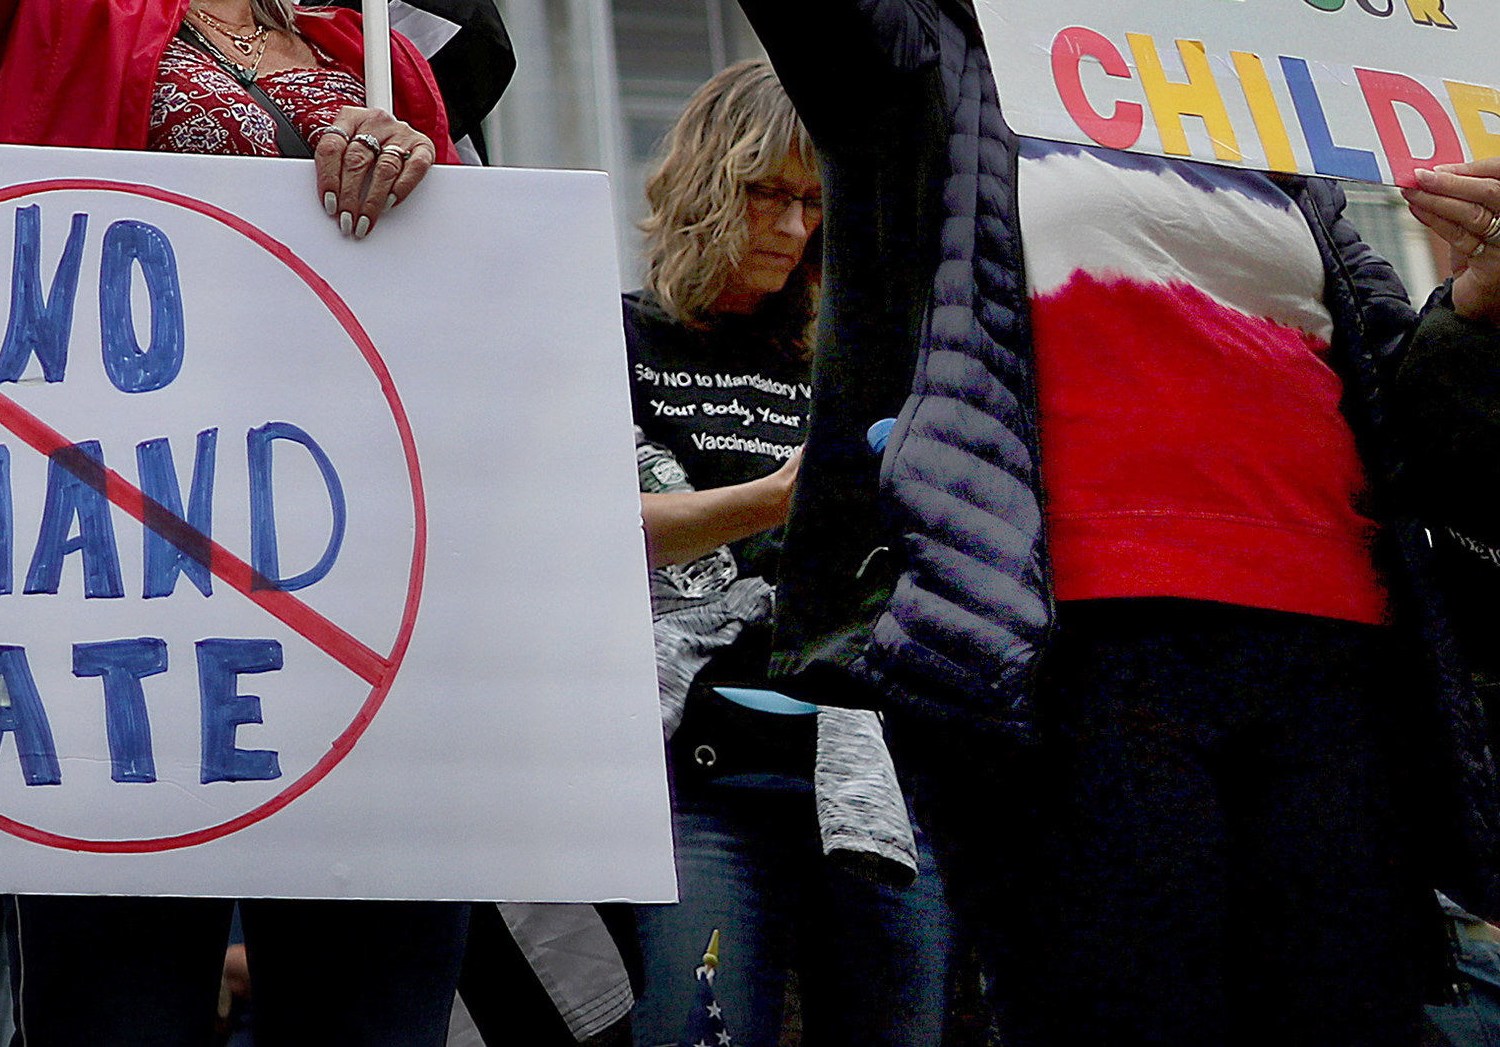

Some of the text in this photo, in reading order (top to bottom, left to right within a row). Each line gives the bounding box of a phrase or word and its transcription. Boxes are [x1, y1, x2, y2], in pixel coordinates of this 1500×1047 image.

[635, 363, 660, 386] Say
[663, 372, 692, 388] NO
[695, 373, 714, 388] to
[716, 373, 797, 401] Mandatory
[650, 399, 697, 416] Your
[756, 406, 801, 428] Your
